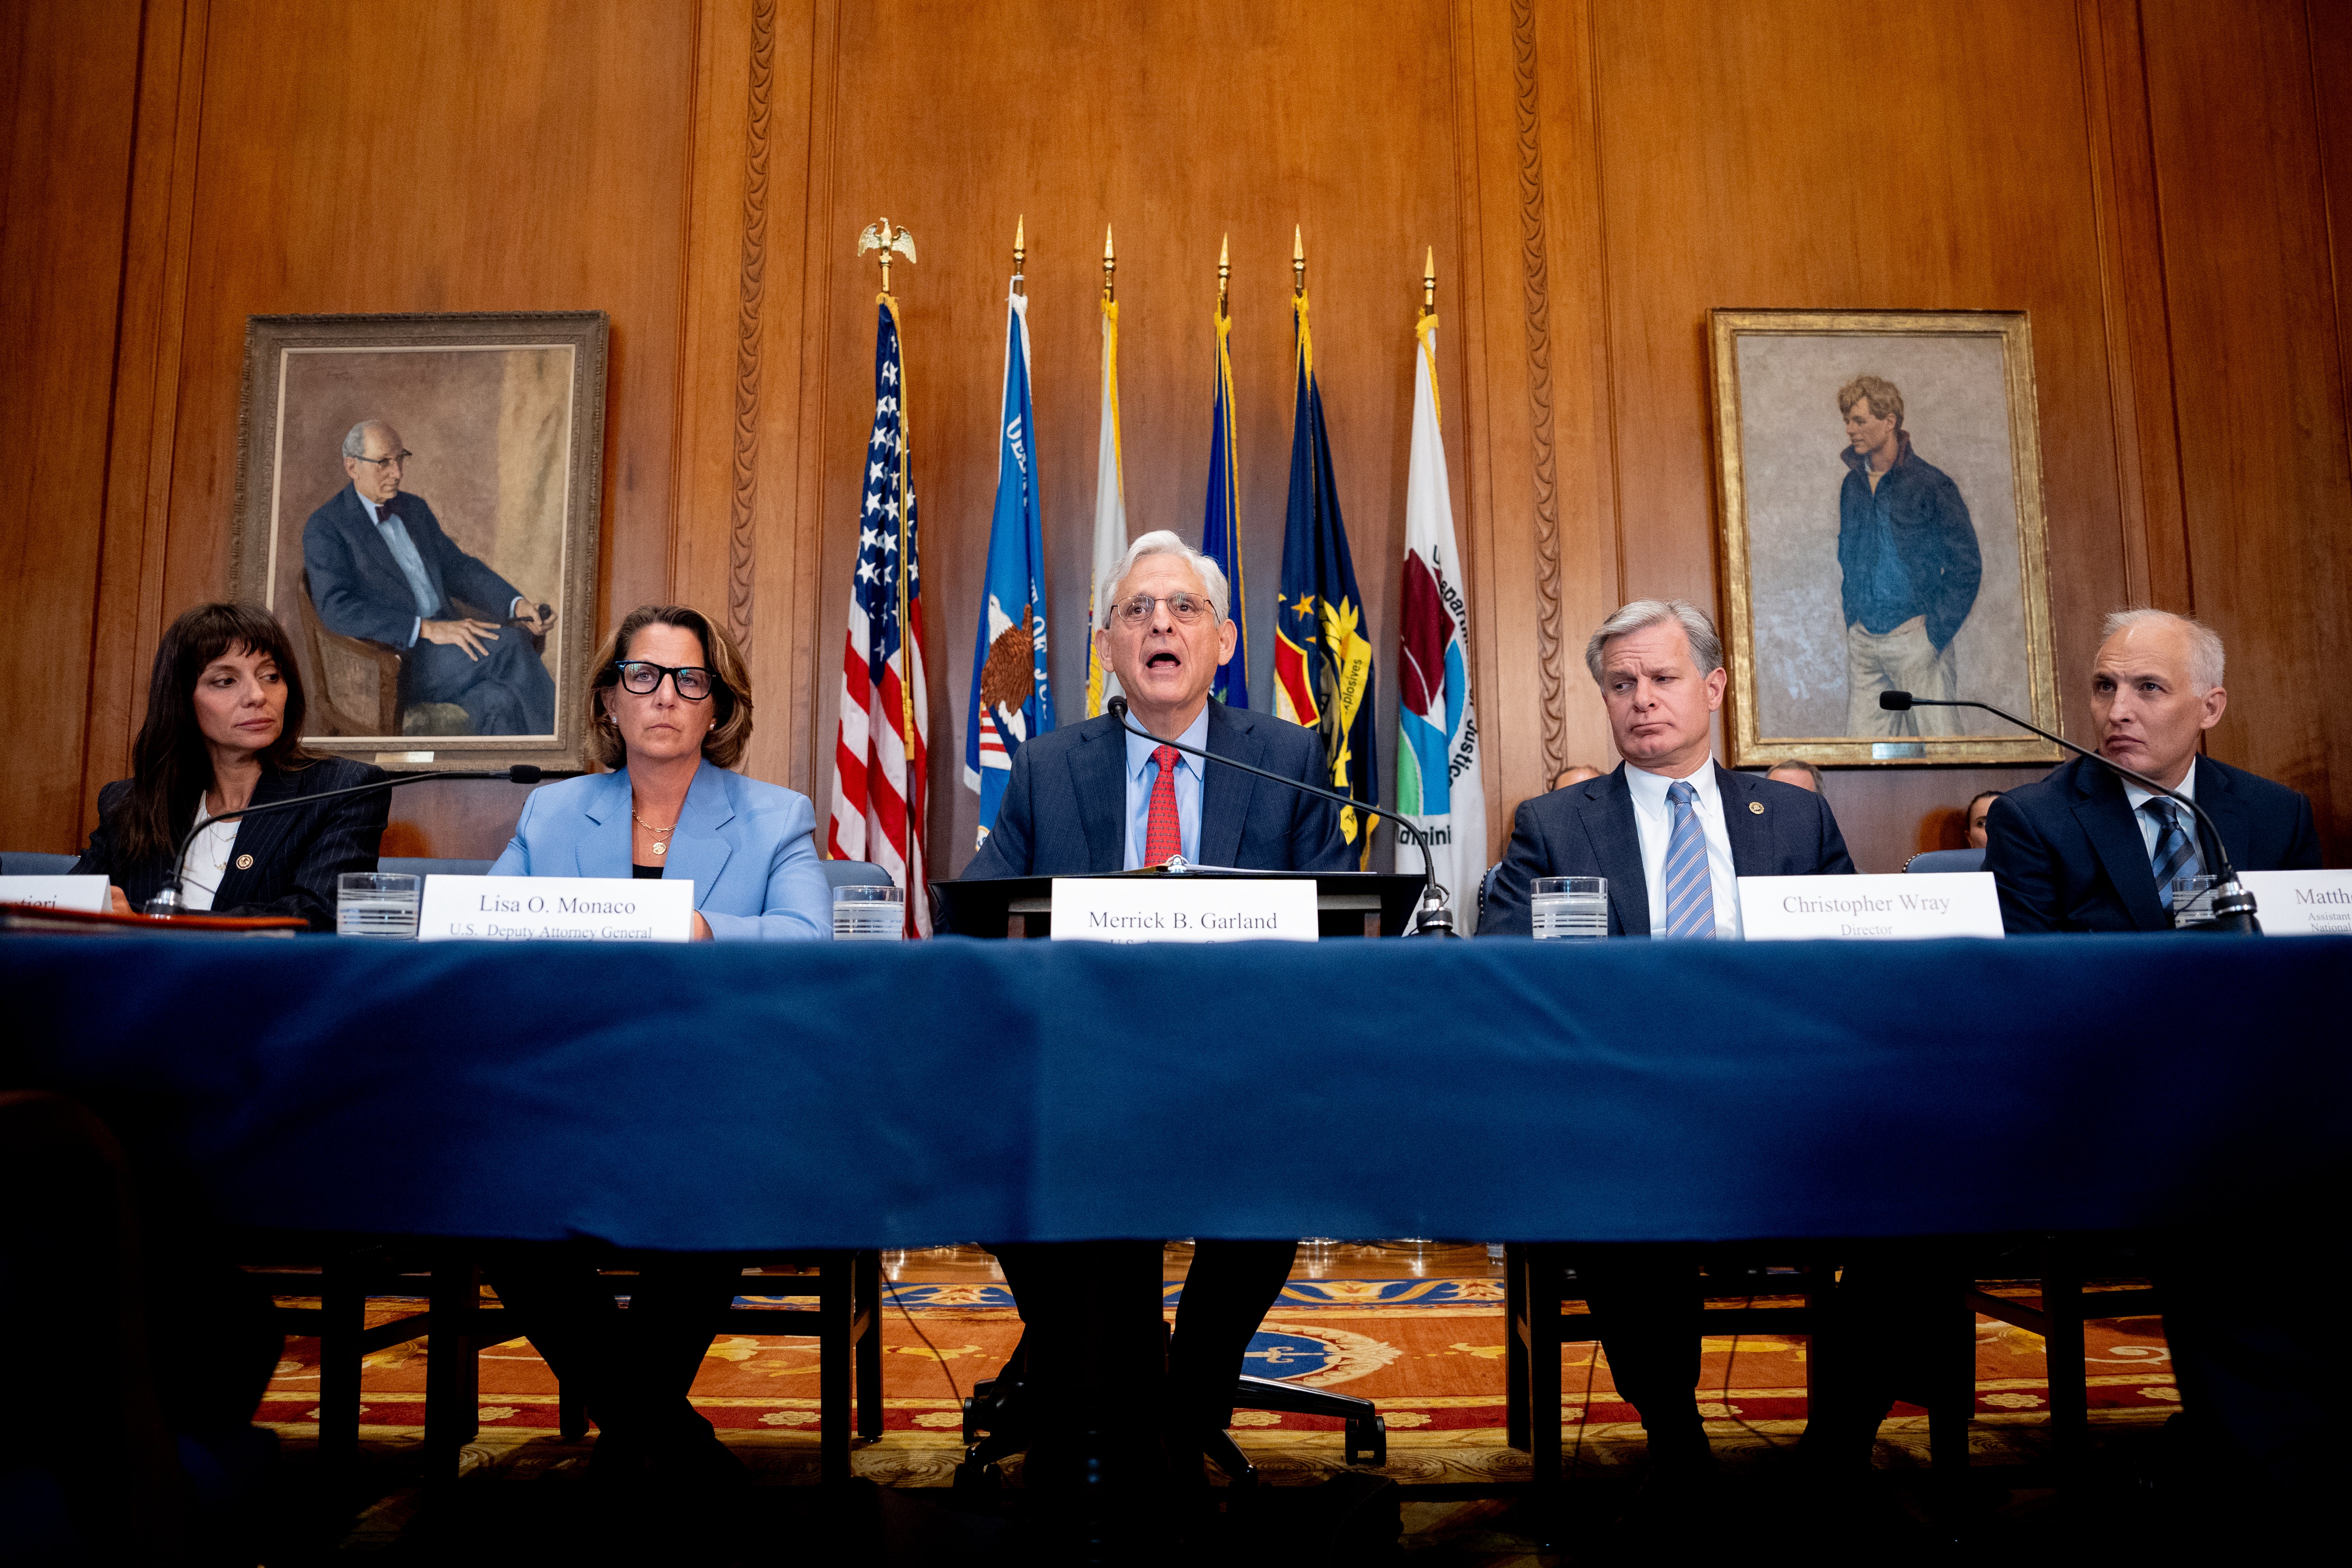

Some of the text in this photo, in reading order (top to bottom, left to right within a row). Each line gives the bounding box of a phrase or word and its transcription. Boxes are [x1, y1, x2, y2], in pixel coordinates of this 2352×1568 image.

[1342, 659, 1363, 715] xplosives
[11, 895, 57, 909] tieri
[2294, 888, 2352, 904] Matth
[480, 895, 636, 914] Lisa O. Monaco
[1783, 894, 1950, 916] Christopher Wray
[1088, 911, 1277, 929] Merrick B. Garland
[2308, 912, 2351, 921] Assistant
[450, 923, 652, 940] U.S. Deputy Attorney General
[1841, 924, 1893, 936] Director
[2310, 922, 2352, 932] National
